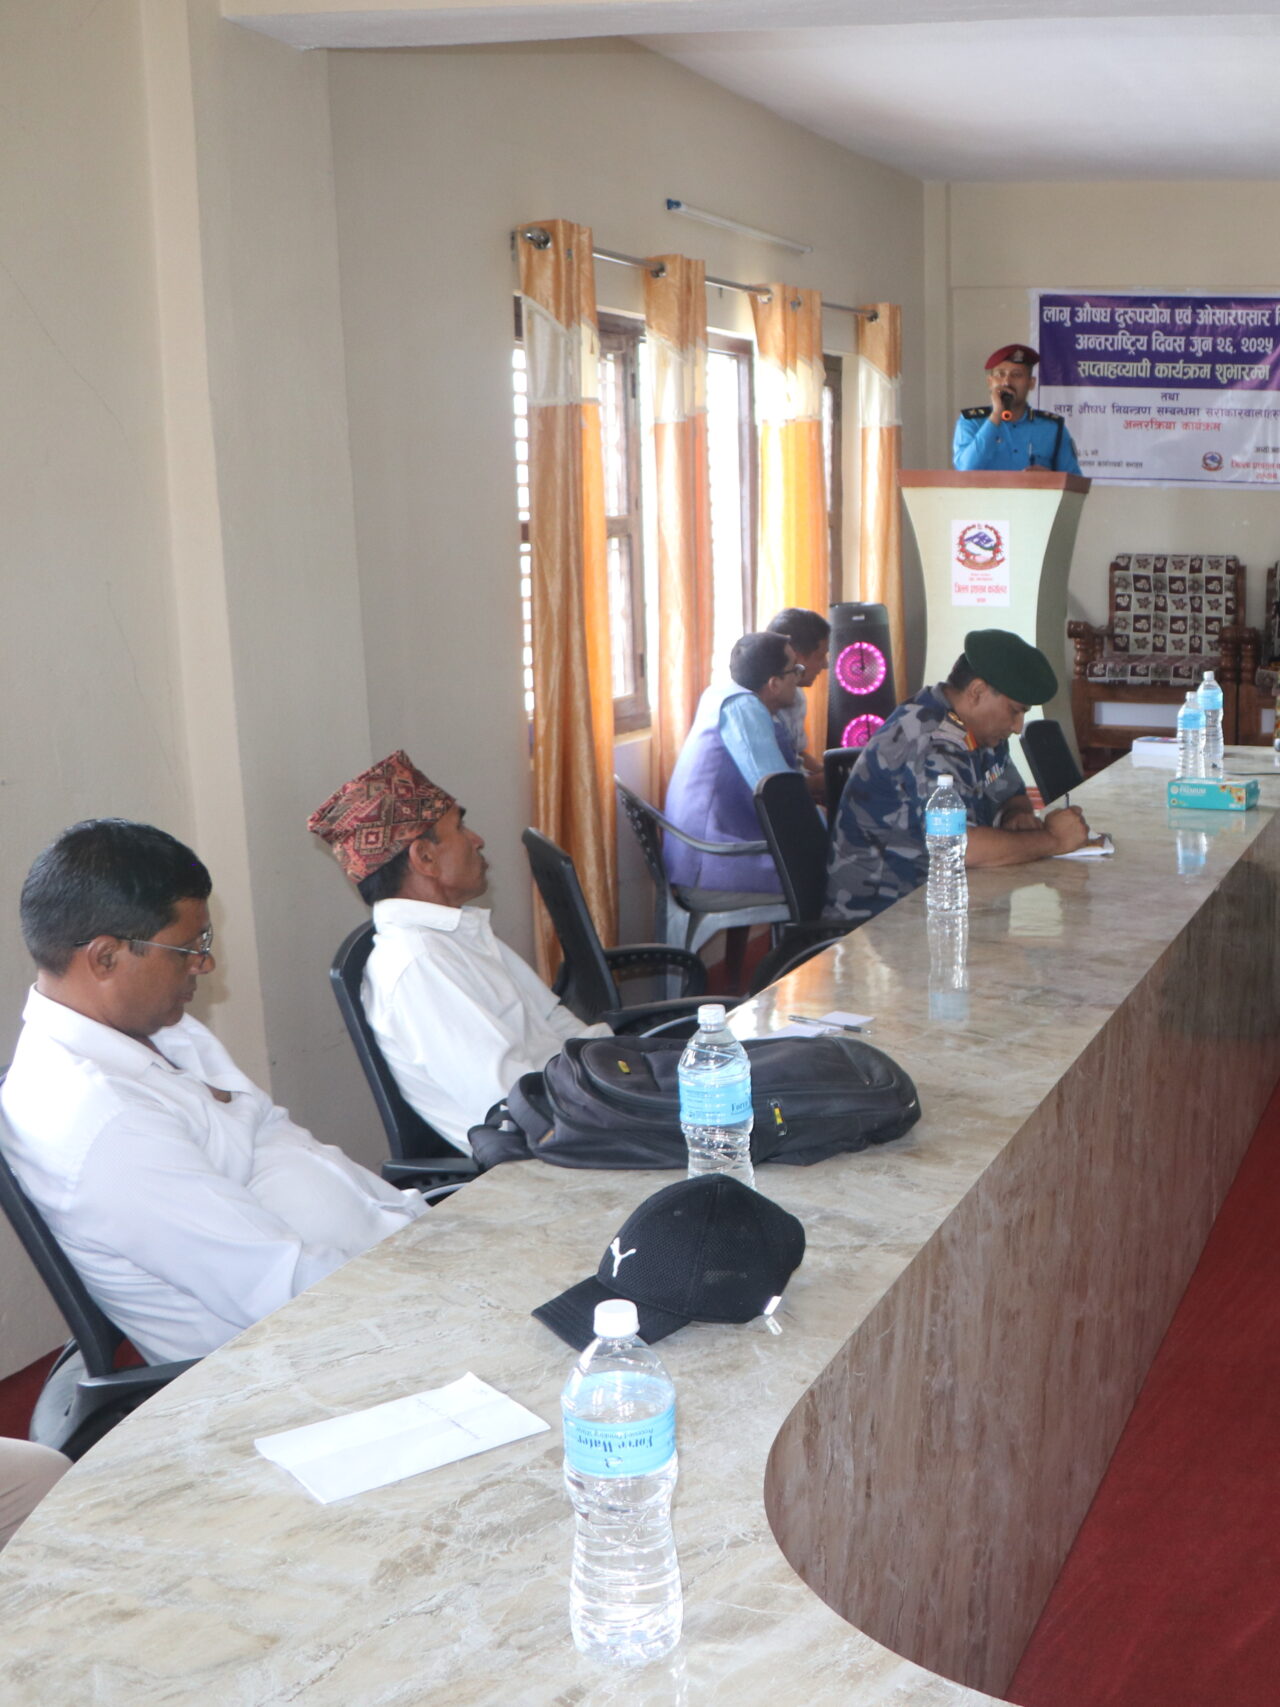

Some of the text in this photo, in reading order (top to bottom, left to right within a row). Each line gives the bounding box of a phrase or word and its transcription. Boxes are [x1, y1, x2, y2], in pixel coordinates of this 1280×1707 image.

[1043, 306, 1071, 327] लागु
[1175, 305, 1192, 324] एवं
[1152, 330, 1186, 352] दिवस
[1189, 336, 1213, 357] जुन
[1241, 337, 1273, 355] २०२५
[1078, 358, 1270, 384] सप्ताहव्यापी कार्यक्रम शुभारम्भ
